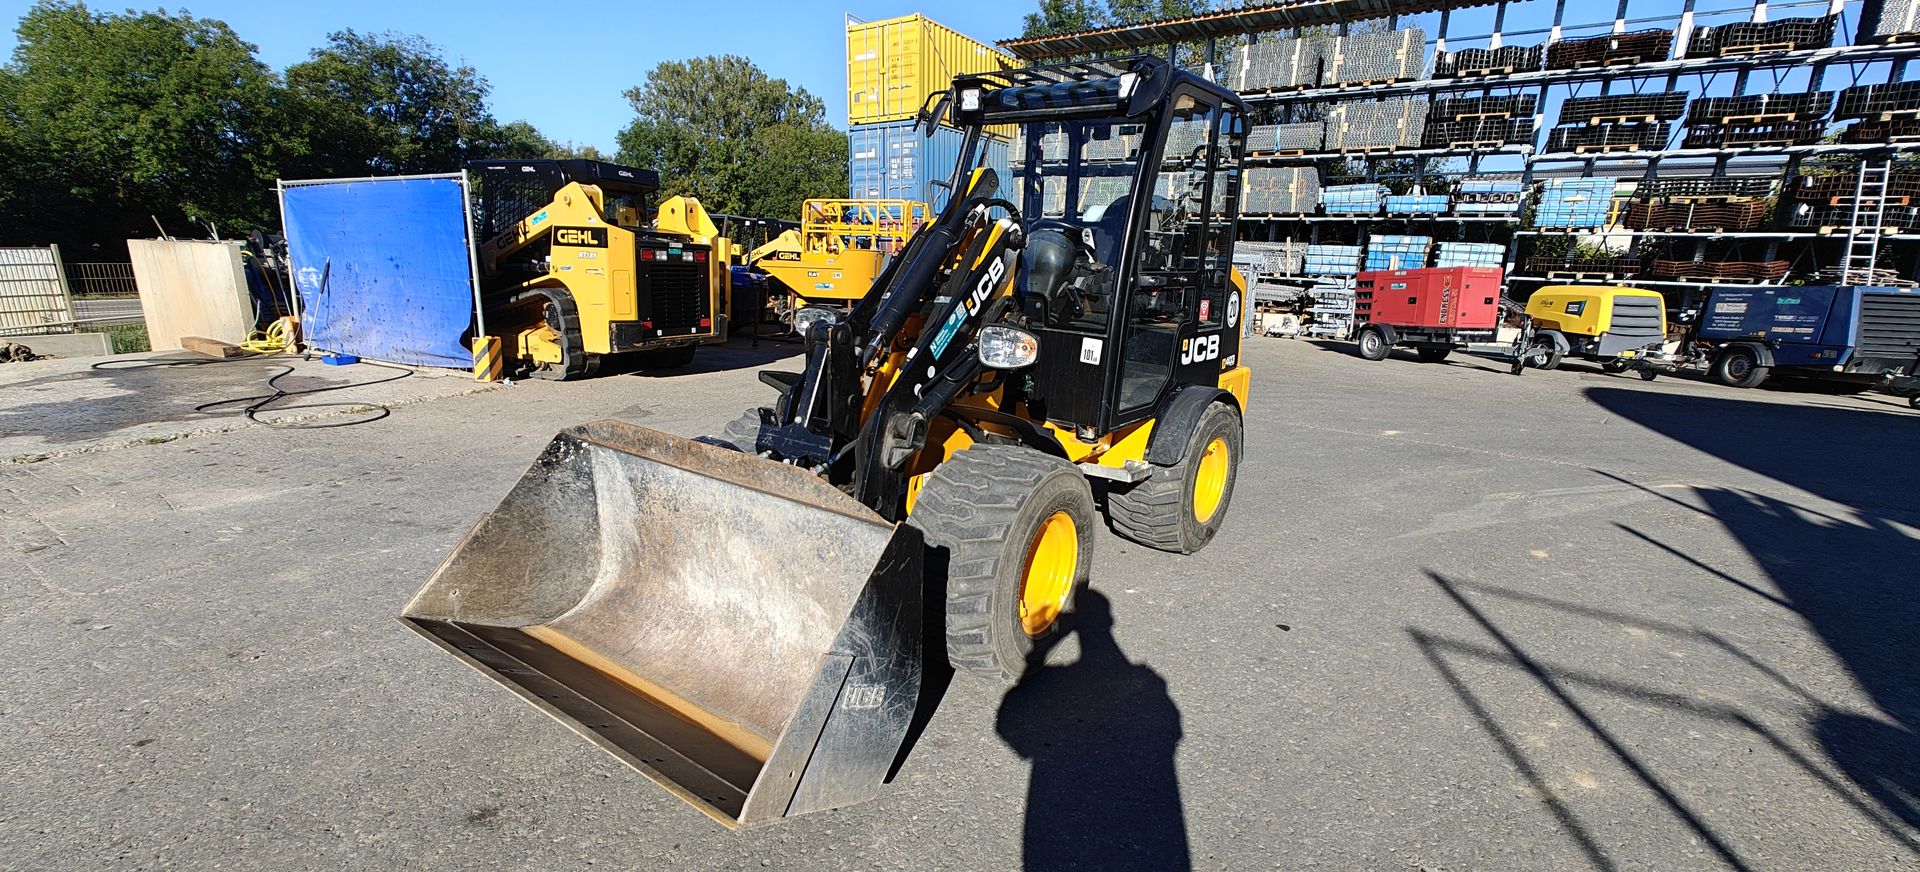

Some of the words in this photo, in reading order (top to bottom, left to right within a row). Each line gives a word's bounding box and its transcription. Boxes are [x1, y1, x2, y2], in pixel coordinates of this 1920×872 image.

[618, 170, 634, 178] GEHL
[556, 229, 599, 245] GEHL
[778, 252, 801, 260] GEHL
[970, 256, 1005, 317] JCB
[1439, 287, 1451, 325] ENDRESS
[1083, 349, 1094, 361] 101
[1181, 334, 1220, 365] JCB
